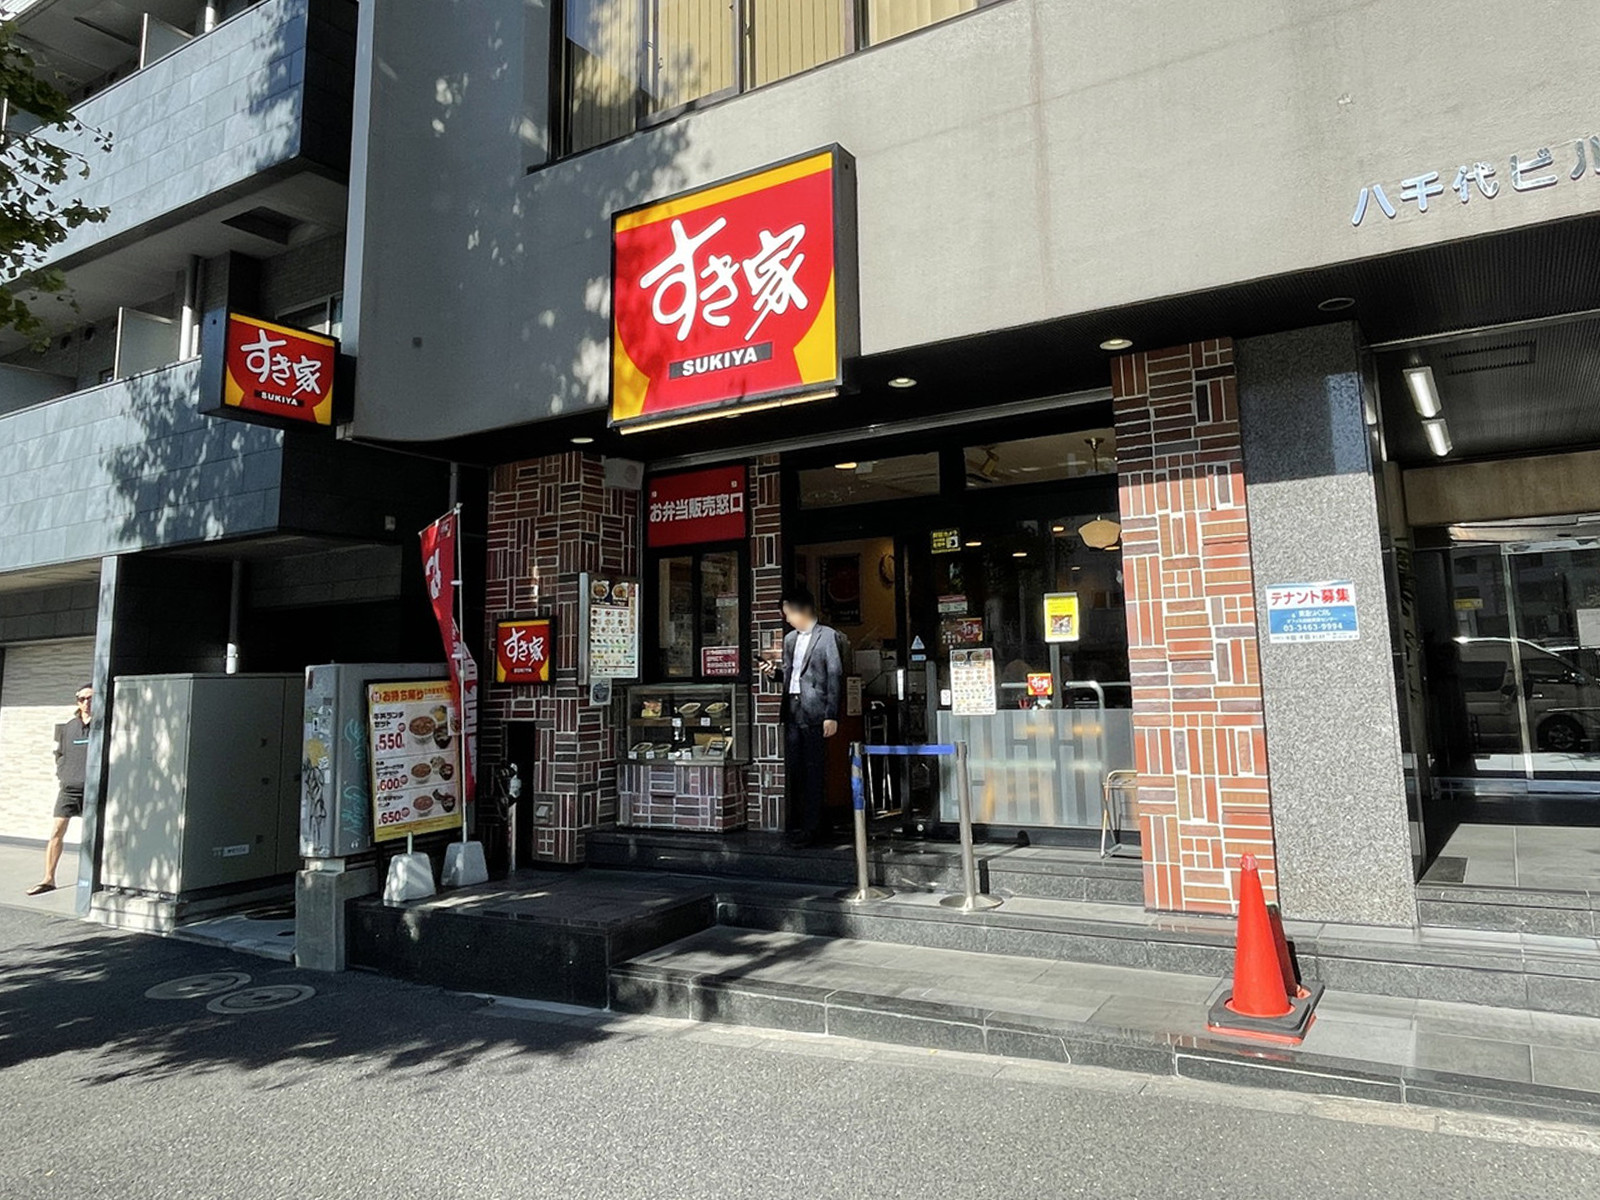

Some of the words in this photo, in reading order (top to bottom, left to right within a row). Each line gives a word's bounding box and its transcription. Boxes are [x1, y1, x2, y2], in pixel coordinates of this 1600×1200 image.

[639, 216, 808, 342] すき家
[240, 328, 322, 397] すき家
[681, 346, 759, 377] SUKIYA
[260, 391, 299, 407] SUKIYA
[649, 491, 744, 523] お弁当販売窓口
[1271, 587, 1351, 606] テナント募集
[503, 627, 544, 667] すき家
[378, 732, 403, 751] 550
[379, 776, 400, 791] 600
[380, 810, 401, 825] 650
